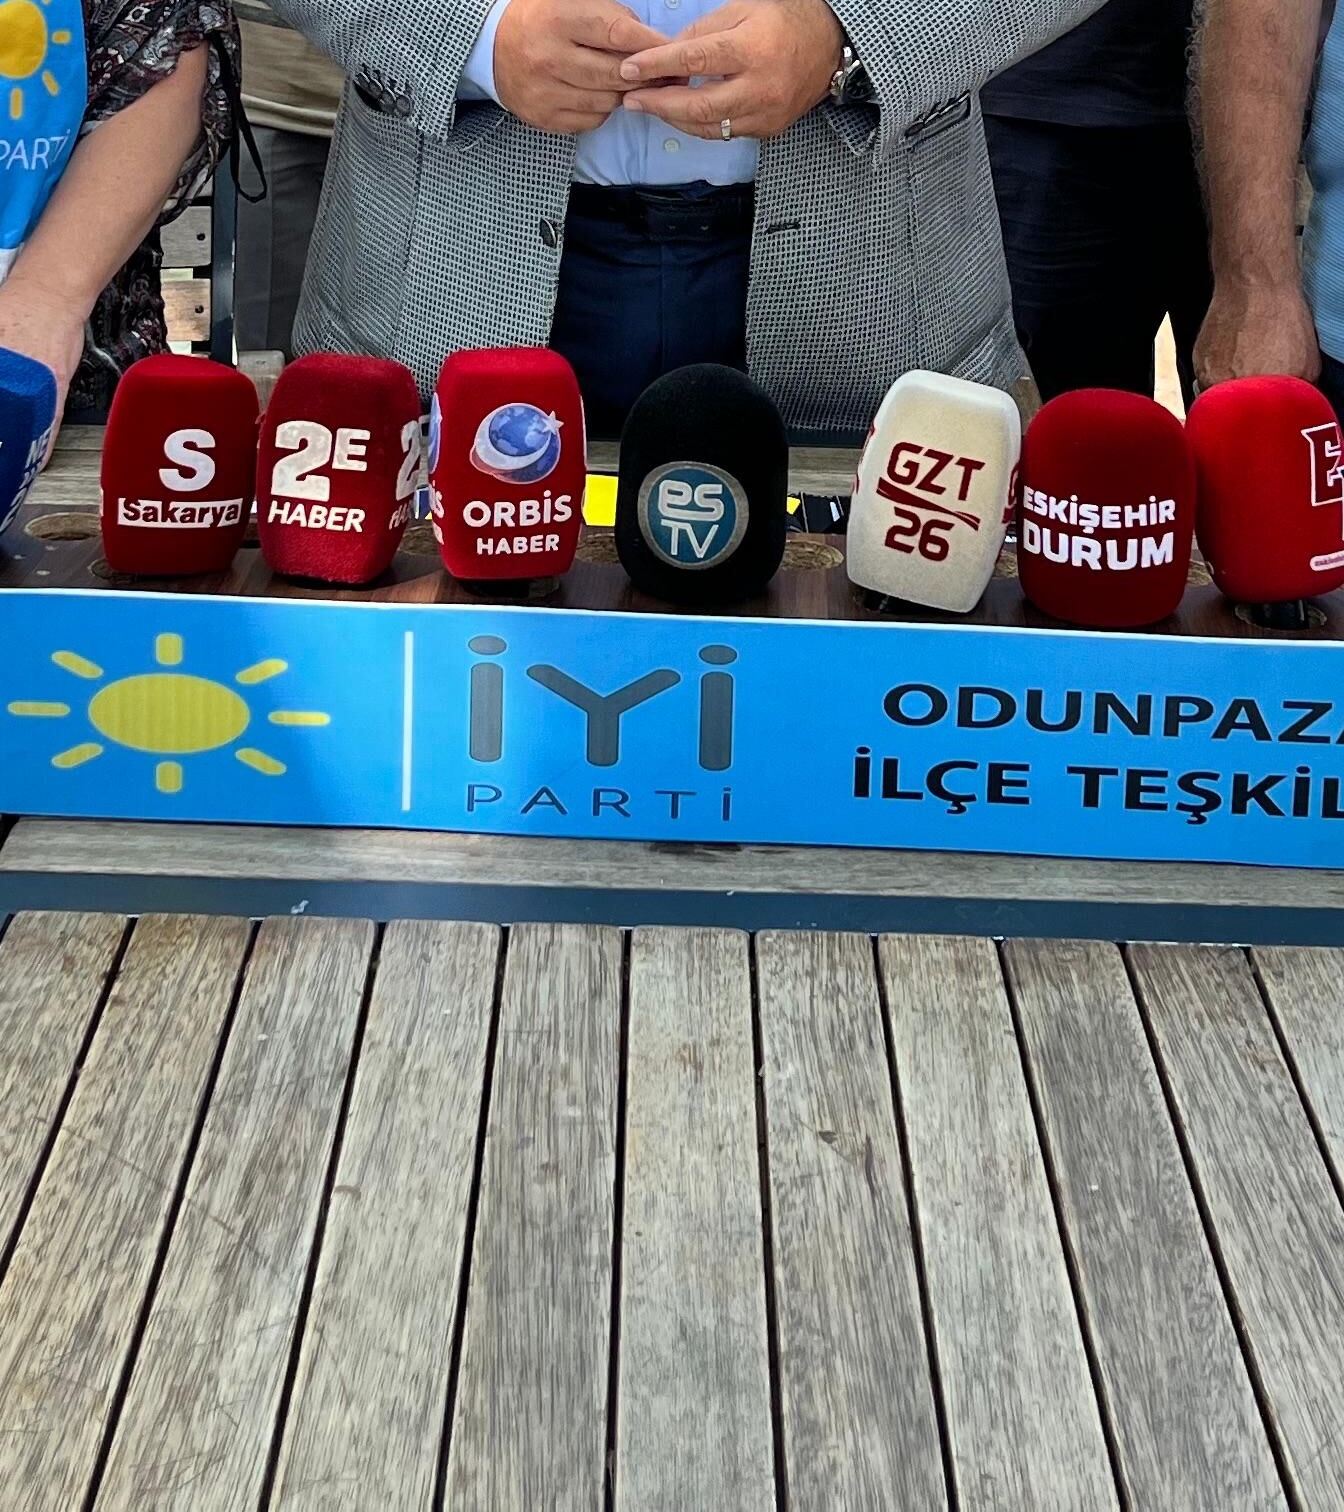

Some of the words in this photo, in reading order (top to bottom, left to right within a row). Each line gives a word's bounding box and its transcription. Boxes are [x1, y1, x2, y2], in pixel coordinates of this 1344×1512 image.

[158, 428, 216, 492] S
[886, 441, 986, 501] GZT
[120, 499, 242, 528] Sakarya
[267, 501, 366, 533] HABER
[463, 489, 573, 528] ORBİS
[1023, 485, 1176, 534] ESKİŞEHİR
[476, 533, 560, 556] HABER
[660, 518, 720, 559] TV
[884, 506, 955, 562] 26
[1023, 519, 1175, 571] DURUM
[467, 633, 737, 773] İYİ
[467, 783, 734, 823] PARTİ
[854, 745, 1030, 815] İLÇE
